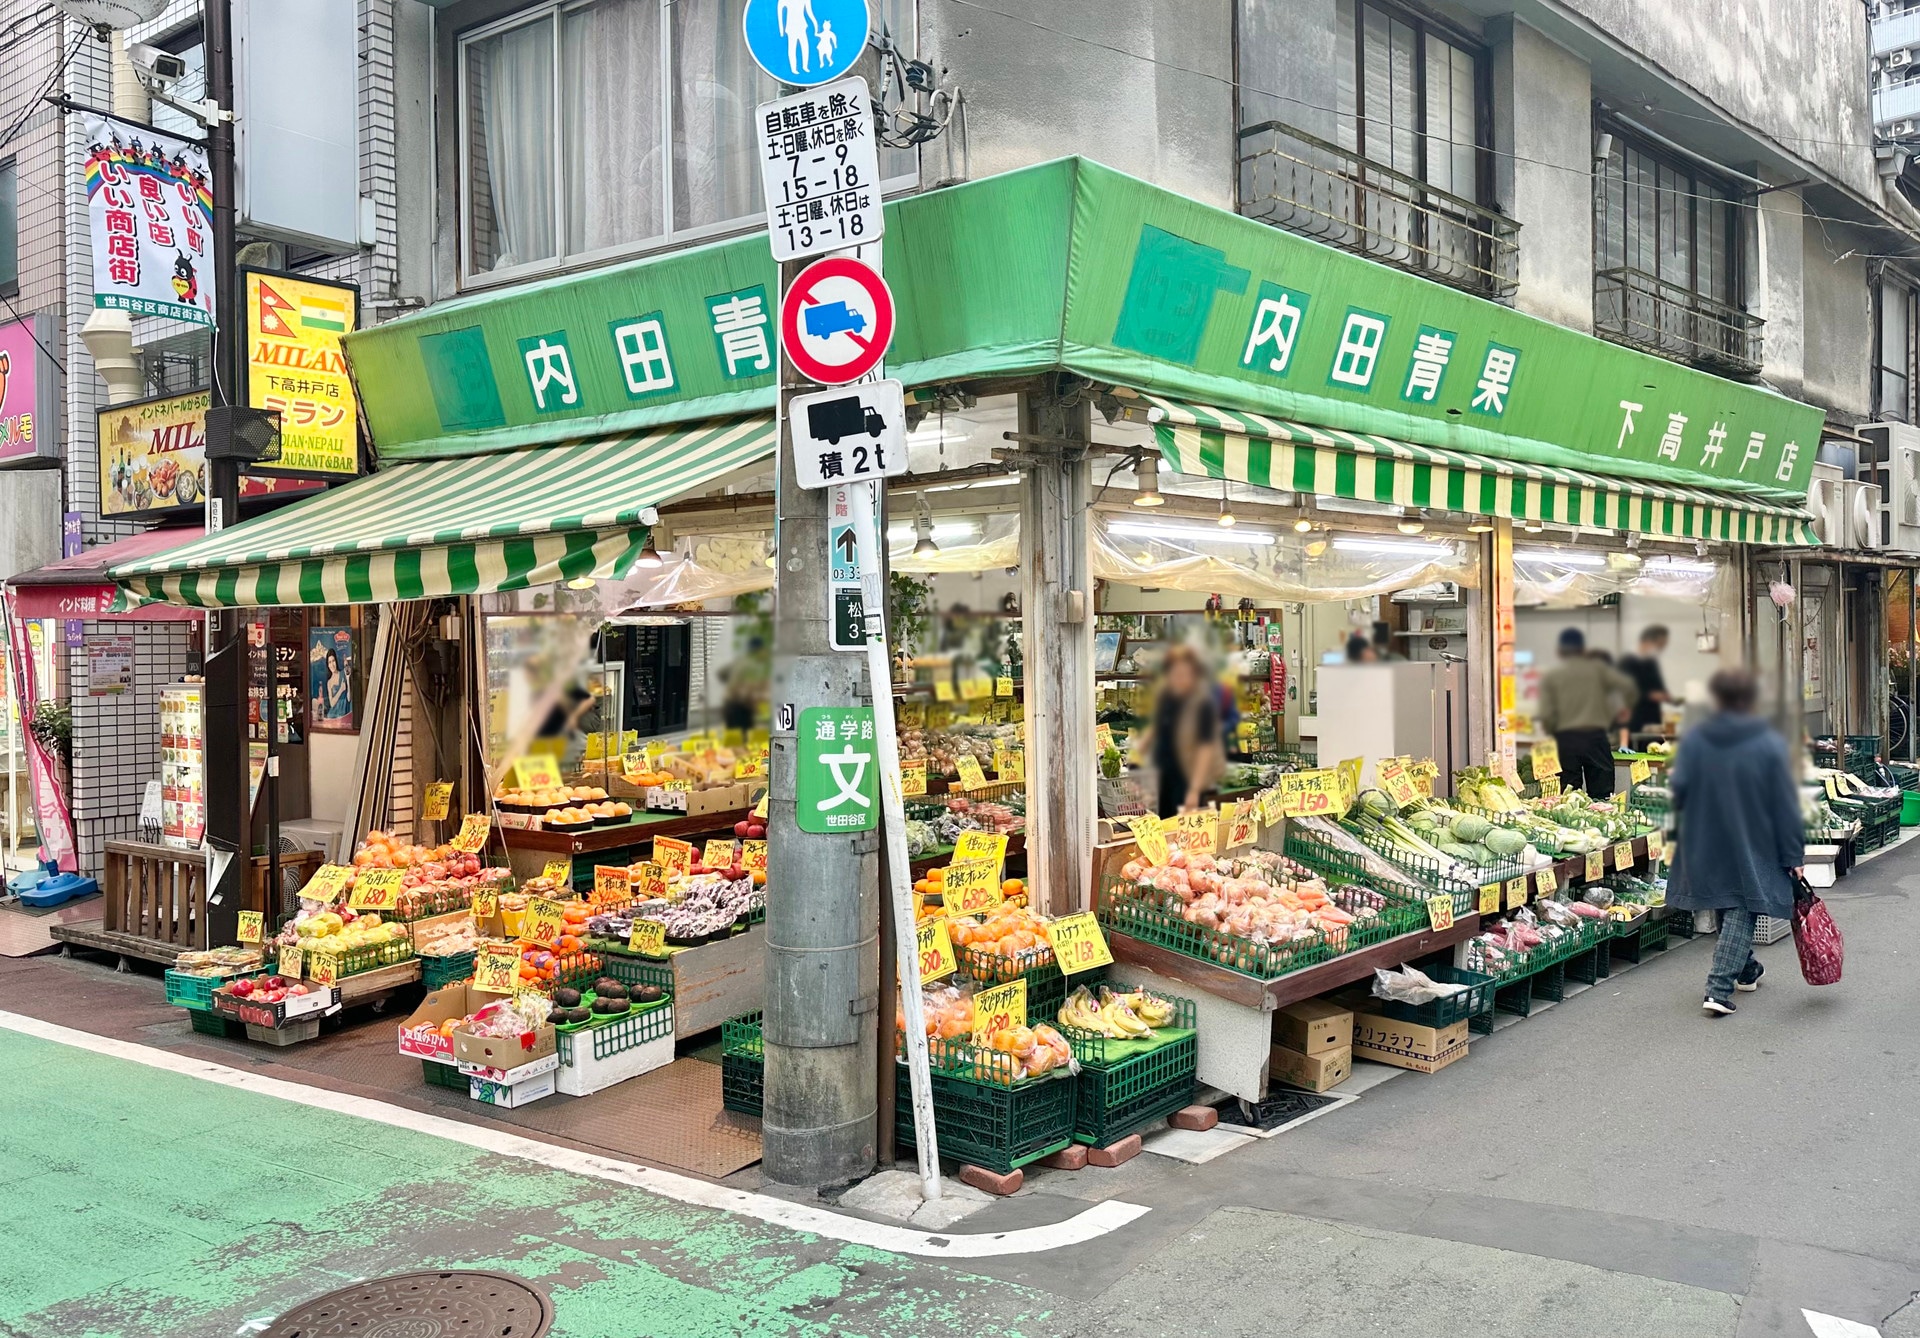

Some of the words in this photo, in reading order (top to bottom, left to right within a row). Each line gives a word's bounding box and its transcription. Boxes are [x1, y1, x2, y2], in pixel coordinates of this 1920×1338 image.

[766, 93, 860, 134] 自転車を除く
[100, 162, 137, 283] いい商店街
[139, 176, 172, 245] 良い店
[176, 183, 202, 254] いい町
[252, 342, 347, 375] MILAN
[525, 295, 771, 409] 内田青
[1243, 293, 1516, 414] 内田青果
[266, 375, 339, 398] 下高井戸店
[266, 397, 345, 427] ミラン
[1617, 400, 1800, 482] 下高井戸店
[59, 596, 96, 613] インド料理
[815, 720, 873, 740] 通学路
[816, 744, 871, 812] 文
[1300, 790, 1329, 812] 150
[825, 813, 866, 827] 世田谷区
[363, 887, 387, 905] 680
[962, 887, 988, 910] 680
[535, 920, 555, 941] 580
[1055, 924, 1080, 942] バナナ
[920, 948, 941, 976] 80
[1074, 940, 1094, 963] 168
[487, 970, 511, 988] 580
[1353, 1022, 1427, 1049] カリフラワー
